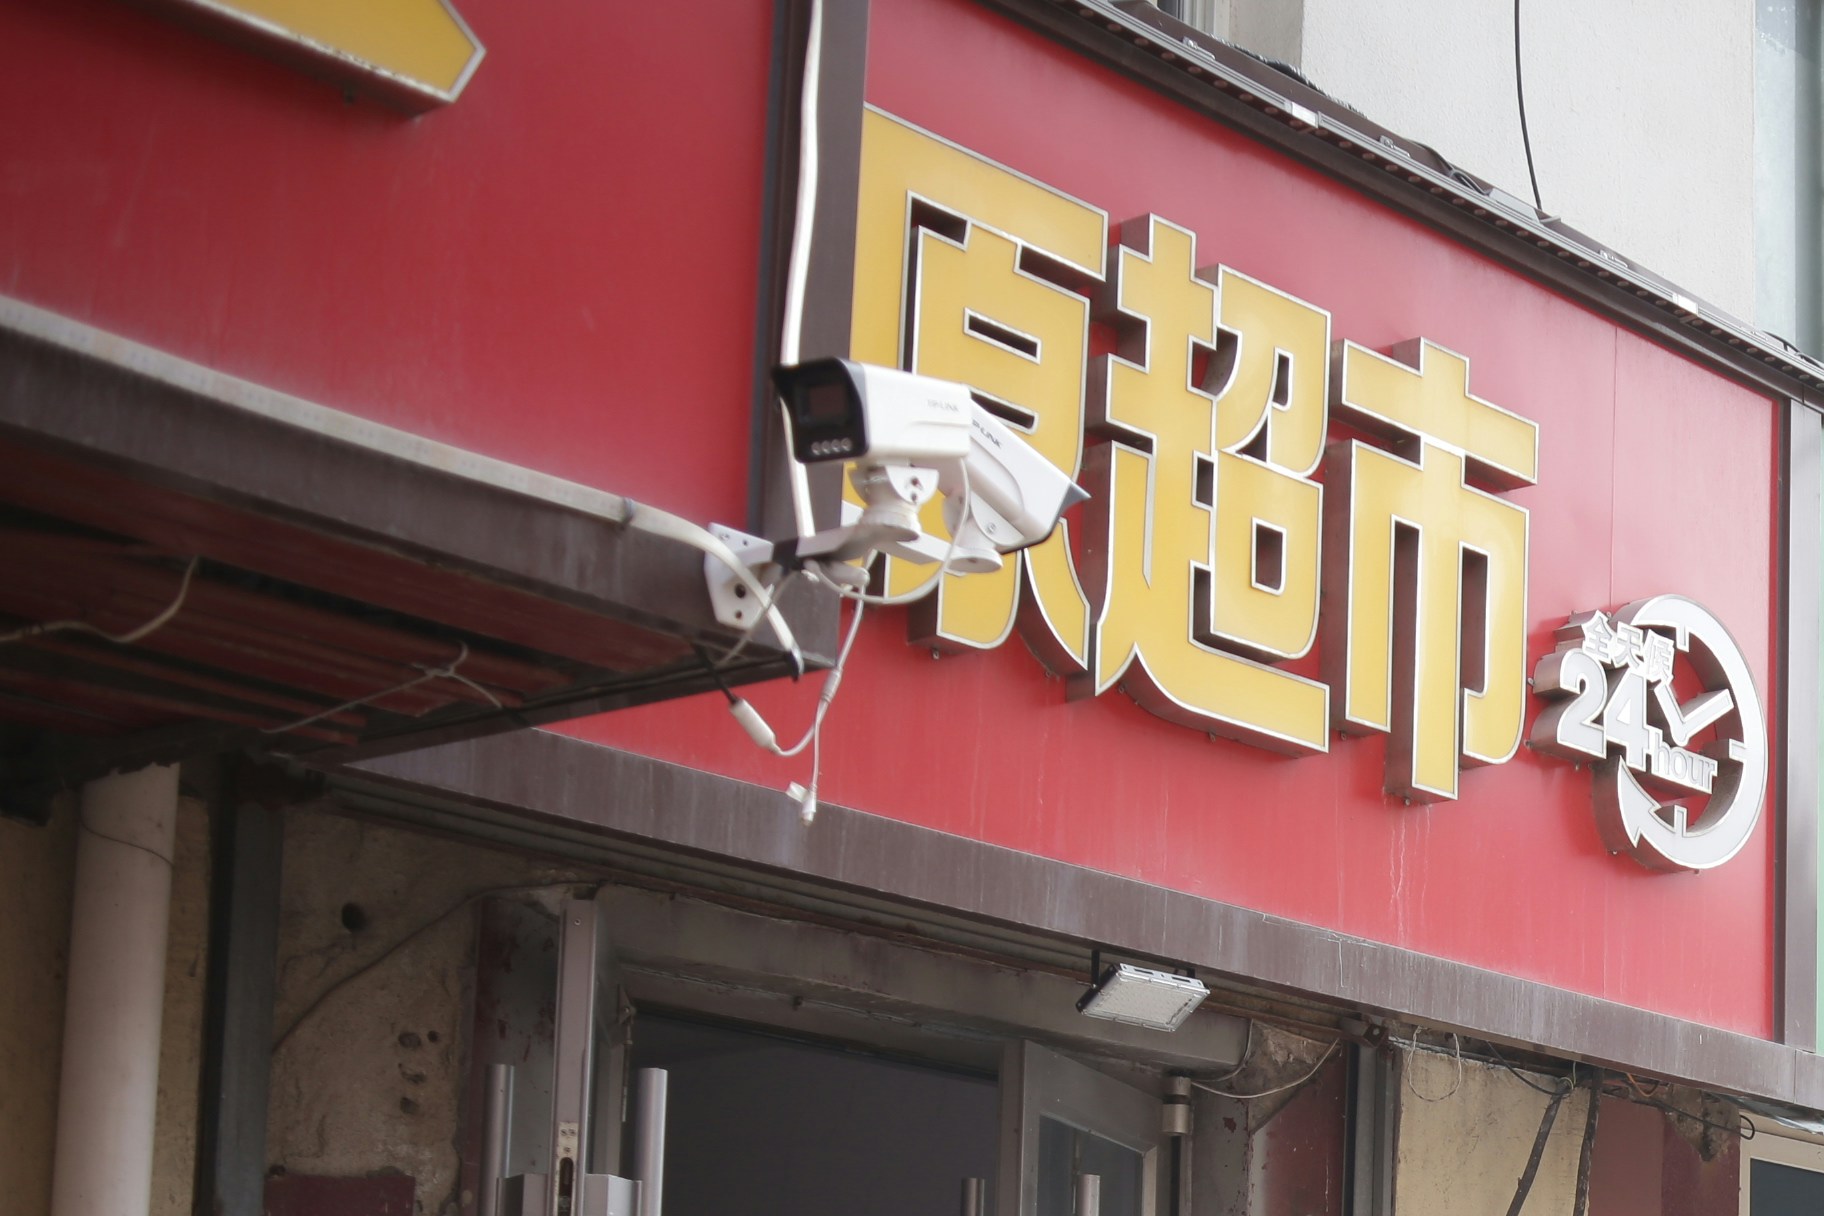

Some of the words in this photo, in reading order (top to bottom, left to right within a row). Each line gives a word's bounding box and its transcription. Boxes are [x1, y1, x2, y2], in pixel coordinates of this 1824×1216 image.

[1581, 609, 1675, 684] 全天候
[1556, 647, 1652, 772] 24
[1651, 728, 1718, 795] hour
